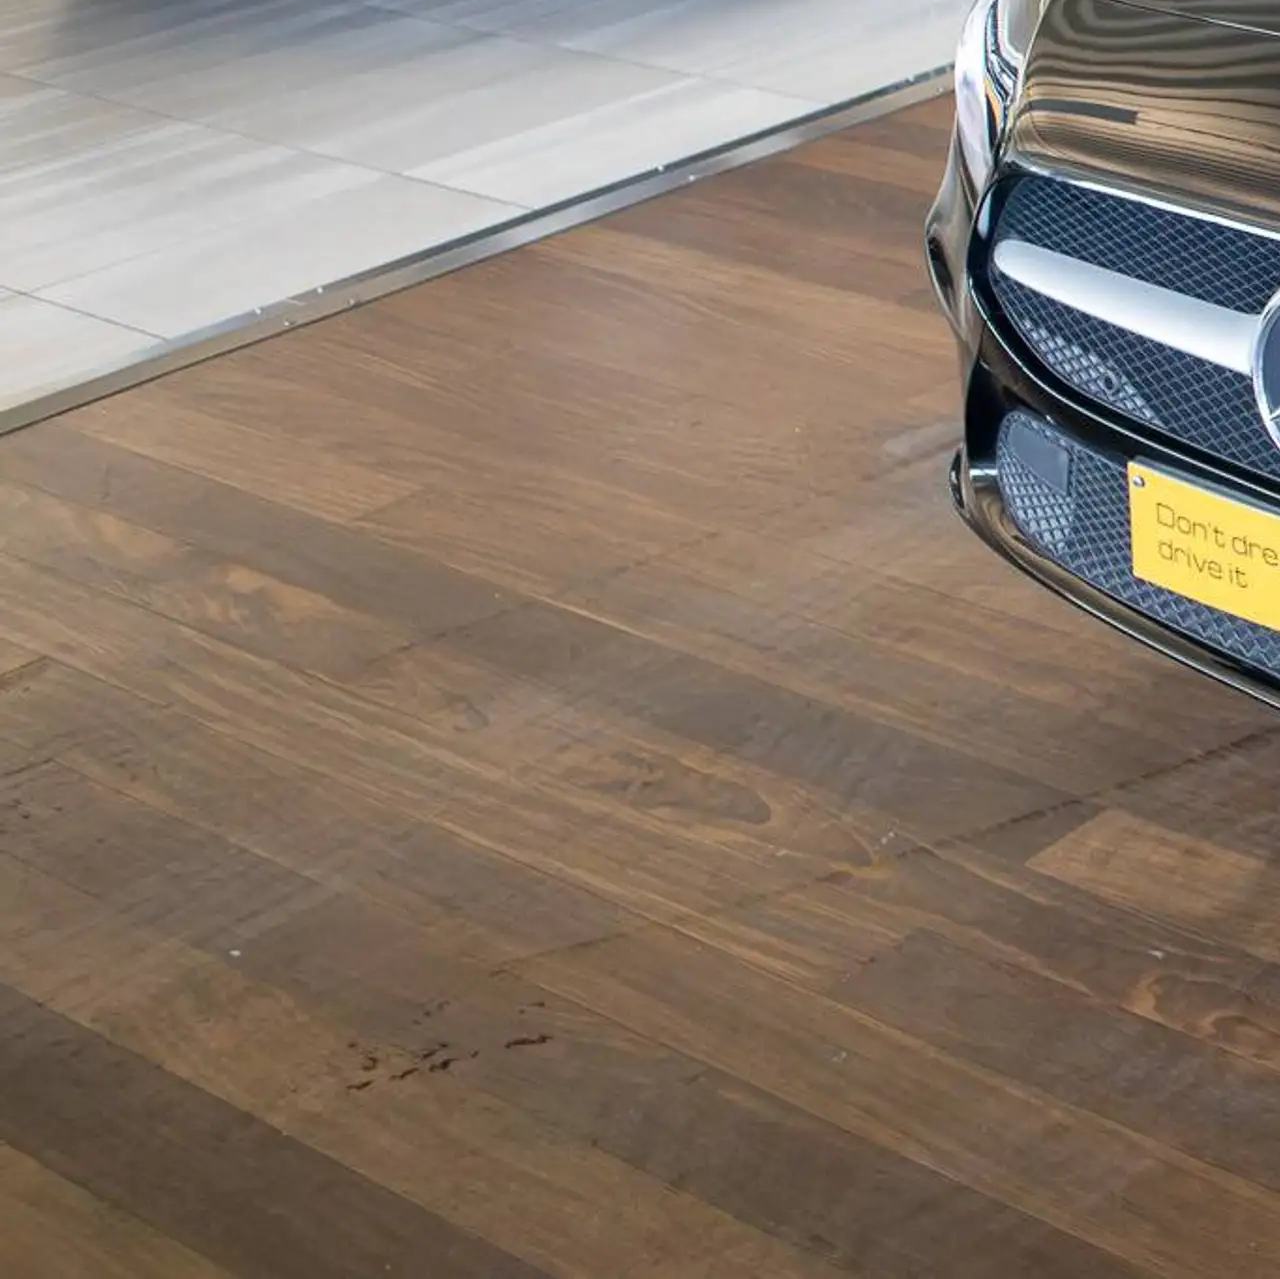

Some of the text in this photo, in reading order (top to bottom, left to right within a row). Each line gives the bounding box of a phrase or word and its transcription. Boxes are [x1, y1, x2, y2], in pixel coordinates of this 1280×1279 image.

[1155, 502, 1226, 549] Don't
[1157, 539, 1249, 589] drive it
